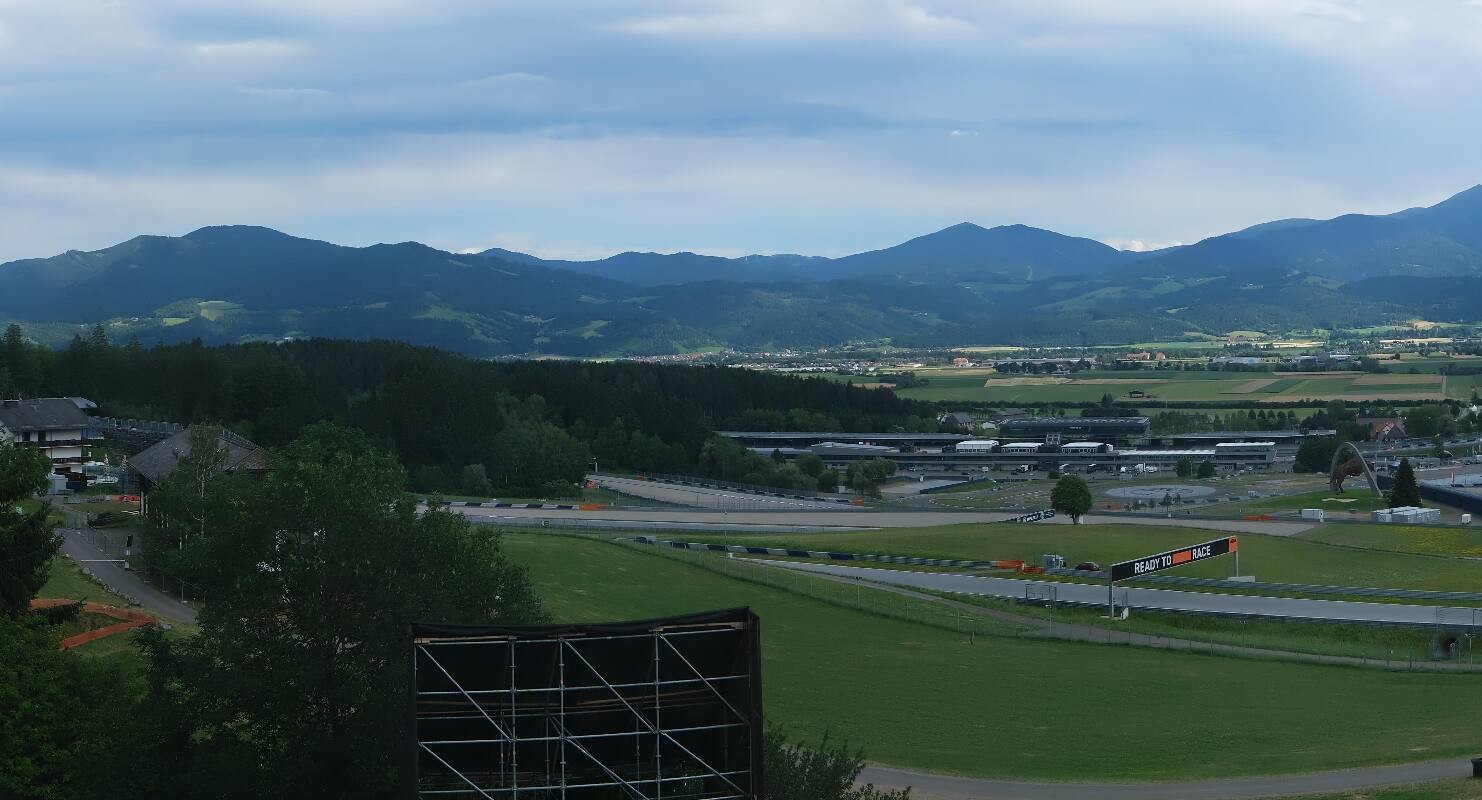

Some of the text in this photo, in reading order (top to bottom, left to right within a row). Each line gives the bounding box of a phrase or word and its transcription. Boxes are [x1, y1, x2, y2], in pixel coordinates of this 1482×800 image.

[1134, 545, 1211, 574] READY TO RACE
